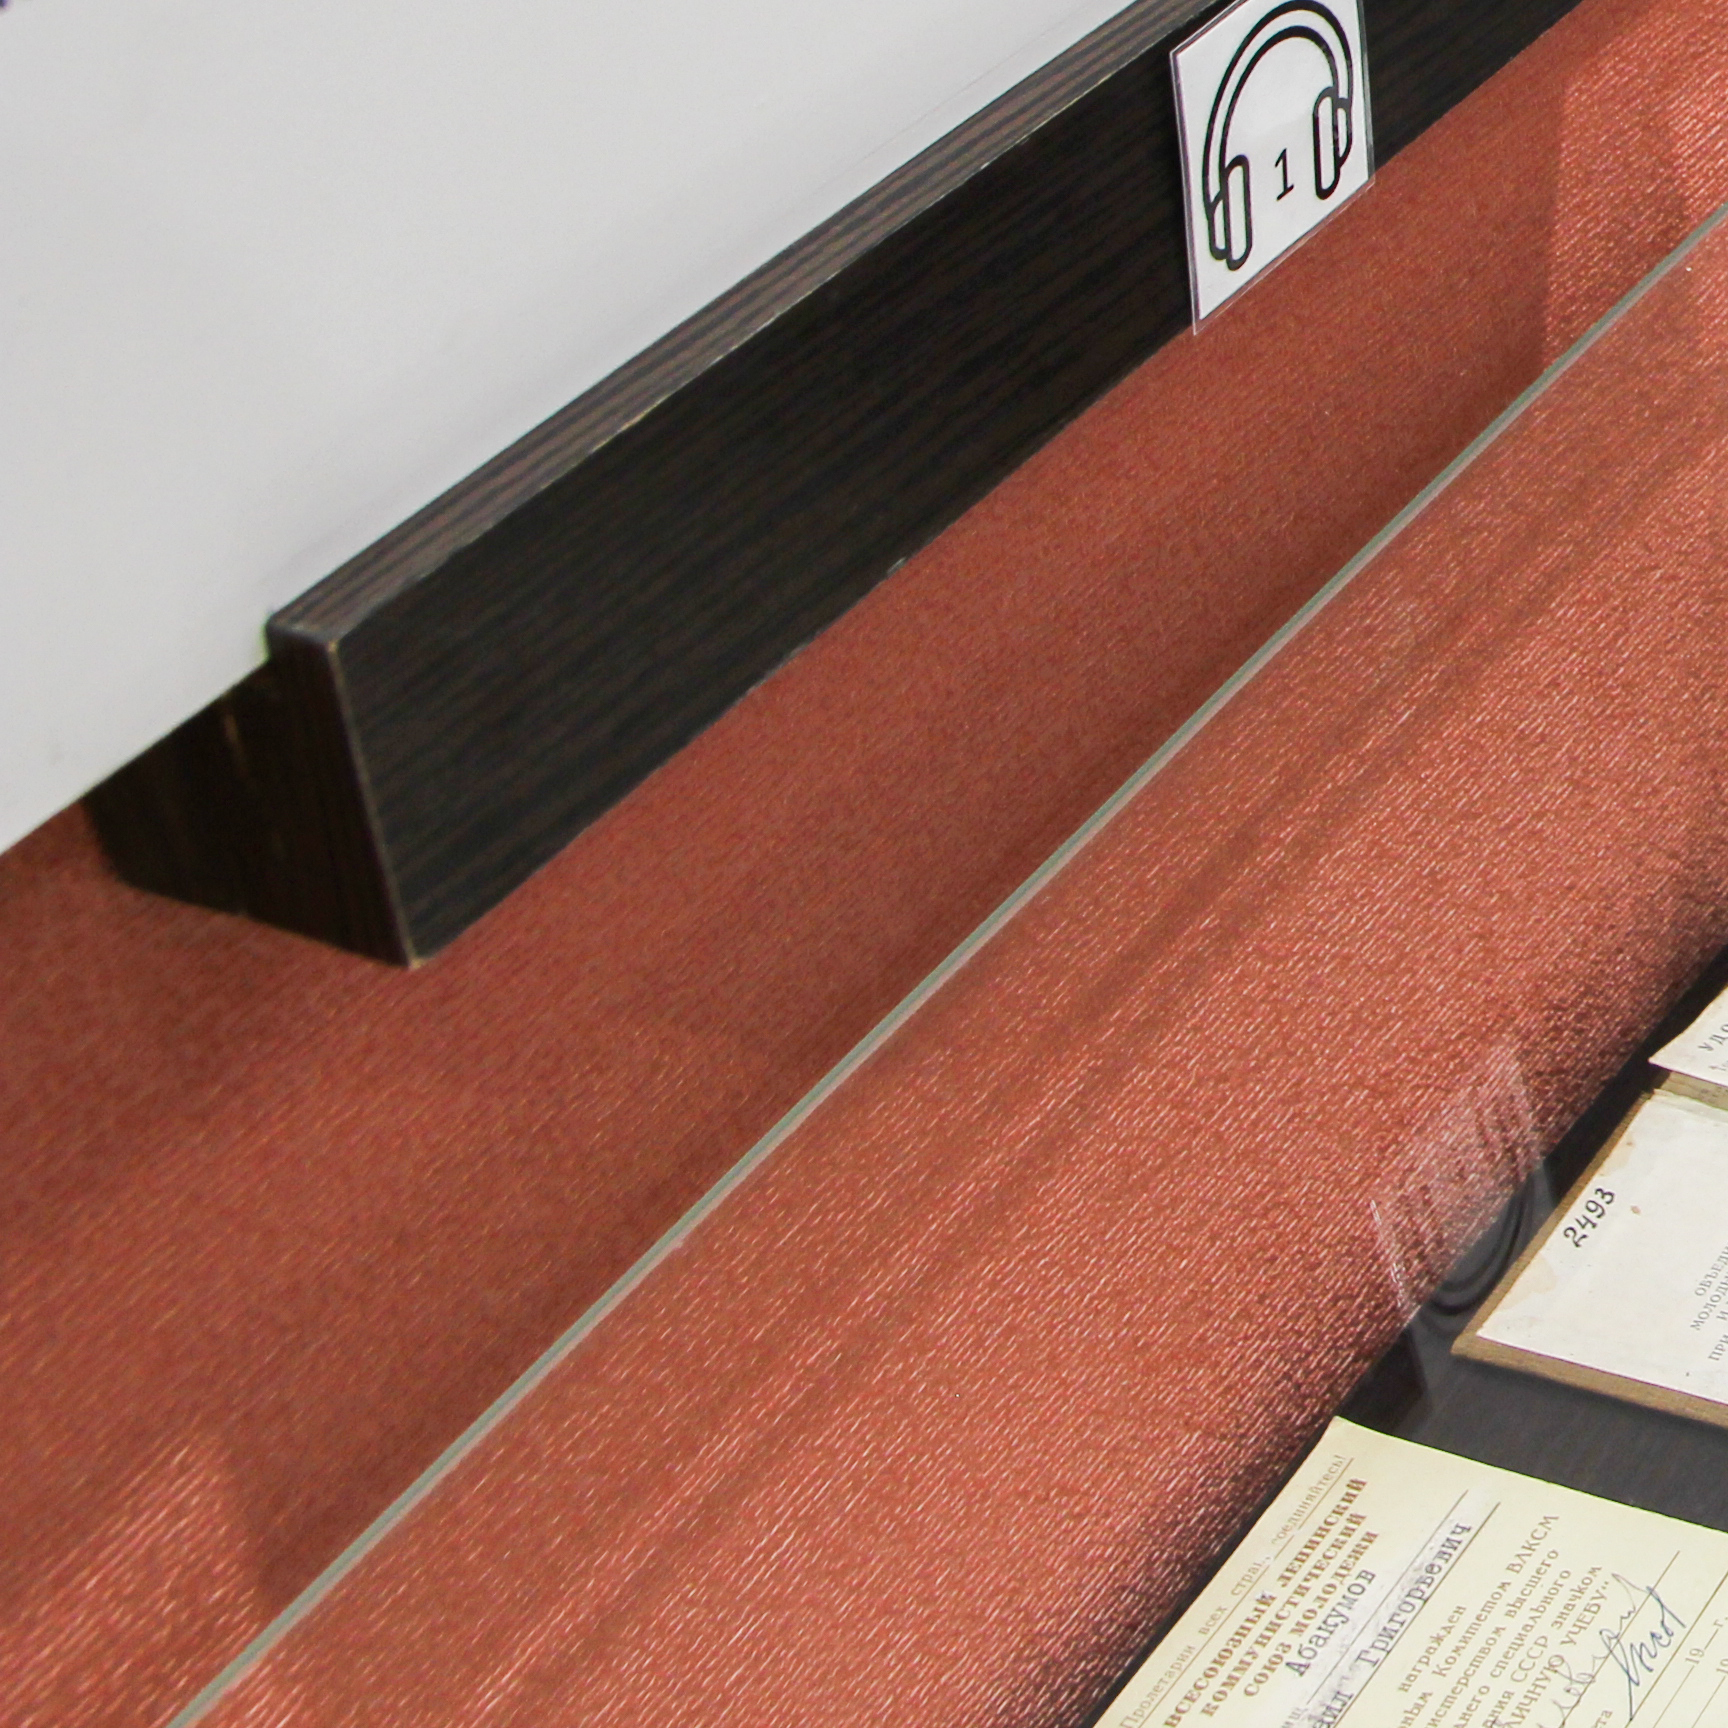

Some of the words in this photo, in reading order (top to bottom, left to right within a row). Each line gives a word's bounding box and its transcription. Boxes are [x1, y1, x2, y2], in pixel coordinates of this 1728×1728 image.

[1273, 148, 1295, 202] 1
[1563, 1187, 1615, 1248] 2493
[1164, 1594, 1276, 1728] ВСЕСОЮЗНЫЙ
[1278, 1478, 1366, 1587] ЛЕНИНСКИЙ
[1198, 1605, 1228, 1635] всех
[1202, 1513, 1366, 1715] КОММУНИСТИЧЕСКИЙ
[1243, 1642, 1292, 1697] СОЮЗ
[1290, 1531, 1378, 1634] МОЛОДЕЖИ
[1285, 1569, 1376, 1676] Абакумов
[1355, 1524, 1481, 1668] Григорьевич
[1431, 1581, 1511, 1677] Комитетом
[1505, 1515, 1559, 1574] ВЛКСМ
[1490, 1570, 1571, 1678] специального
[1504, 1549, 1559, 1618] высшего
[1510, 1634, 1548, 1683] СССР
[1551, 1566, 1602, 1629] значком
[1398, 1605, 1466, 1692] награжден
